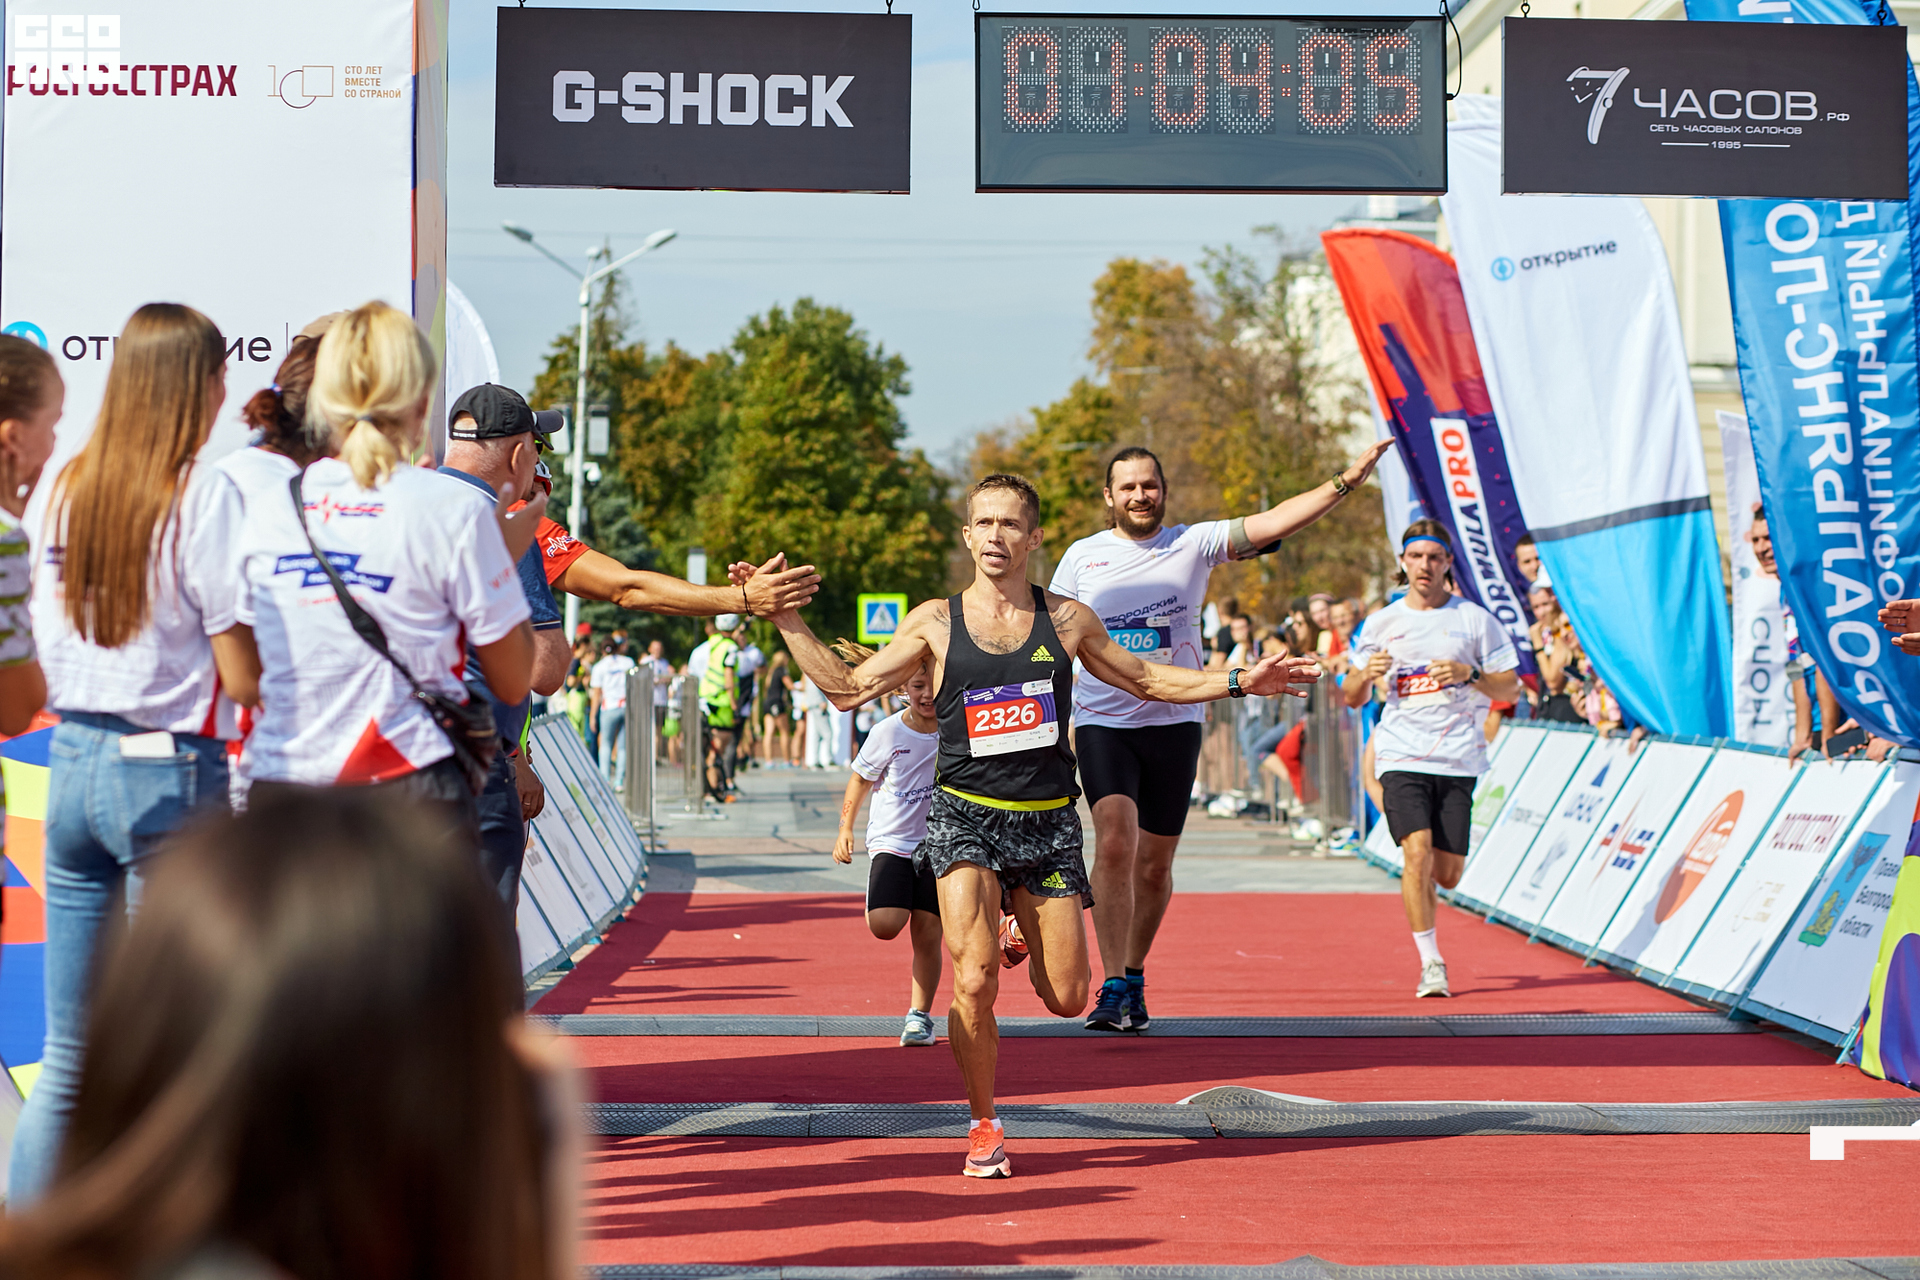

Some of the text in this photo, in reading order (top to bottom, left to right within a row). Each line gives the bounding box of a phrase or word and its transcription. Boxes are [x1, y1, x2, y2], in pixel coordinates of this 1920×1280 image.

[344, 65, 383, 75] СТО ЛЕТ
[344, 77, 382, 87] ВМЕСТЕ
[344, 88, 402, 99] СО СТРАНОЙ
[552, 70, 855, 127] G-SHOCK
[1650, 124, 1803, 135] СЕТЬ ЧАСОВЫХ САЛОНОВ
[1711, 140, 1742, 149] 1995
[1520, 241, 1616, 270] открытие
[62, 335, 272, 362] отие
[1113, 632, 1154, 650] 1306
[974, 703, 1036, 732] 2326
